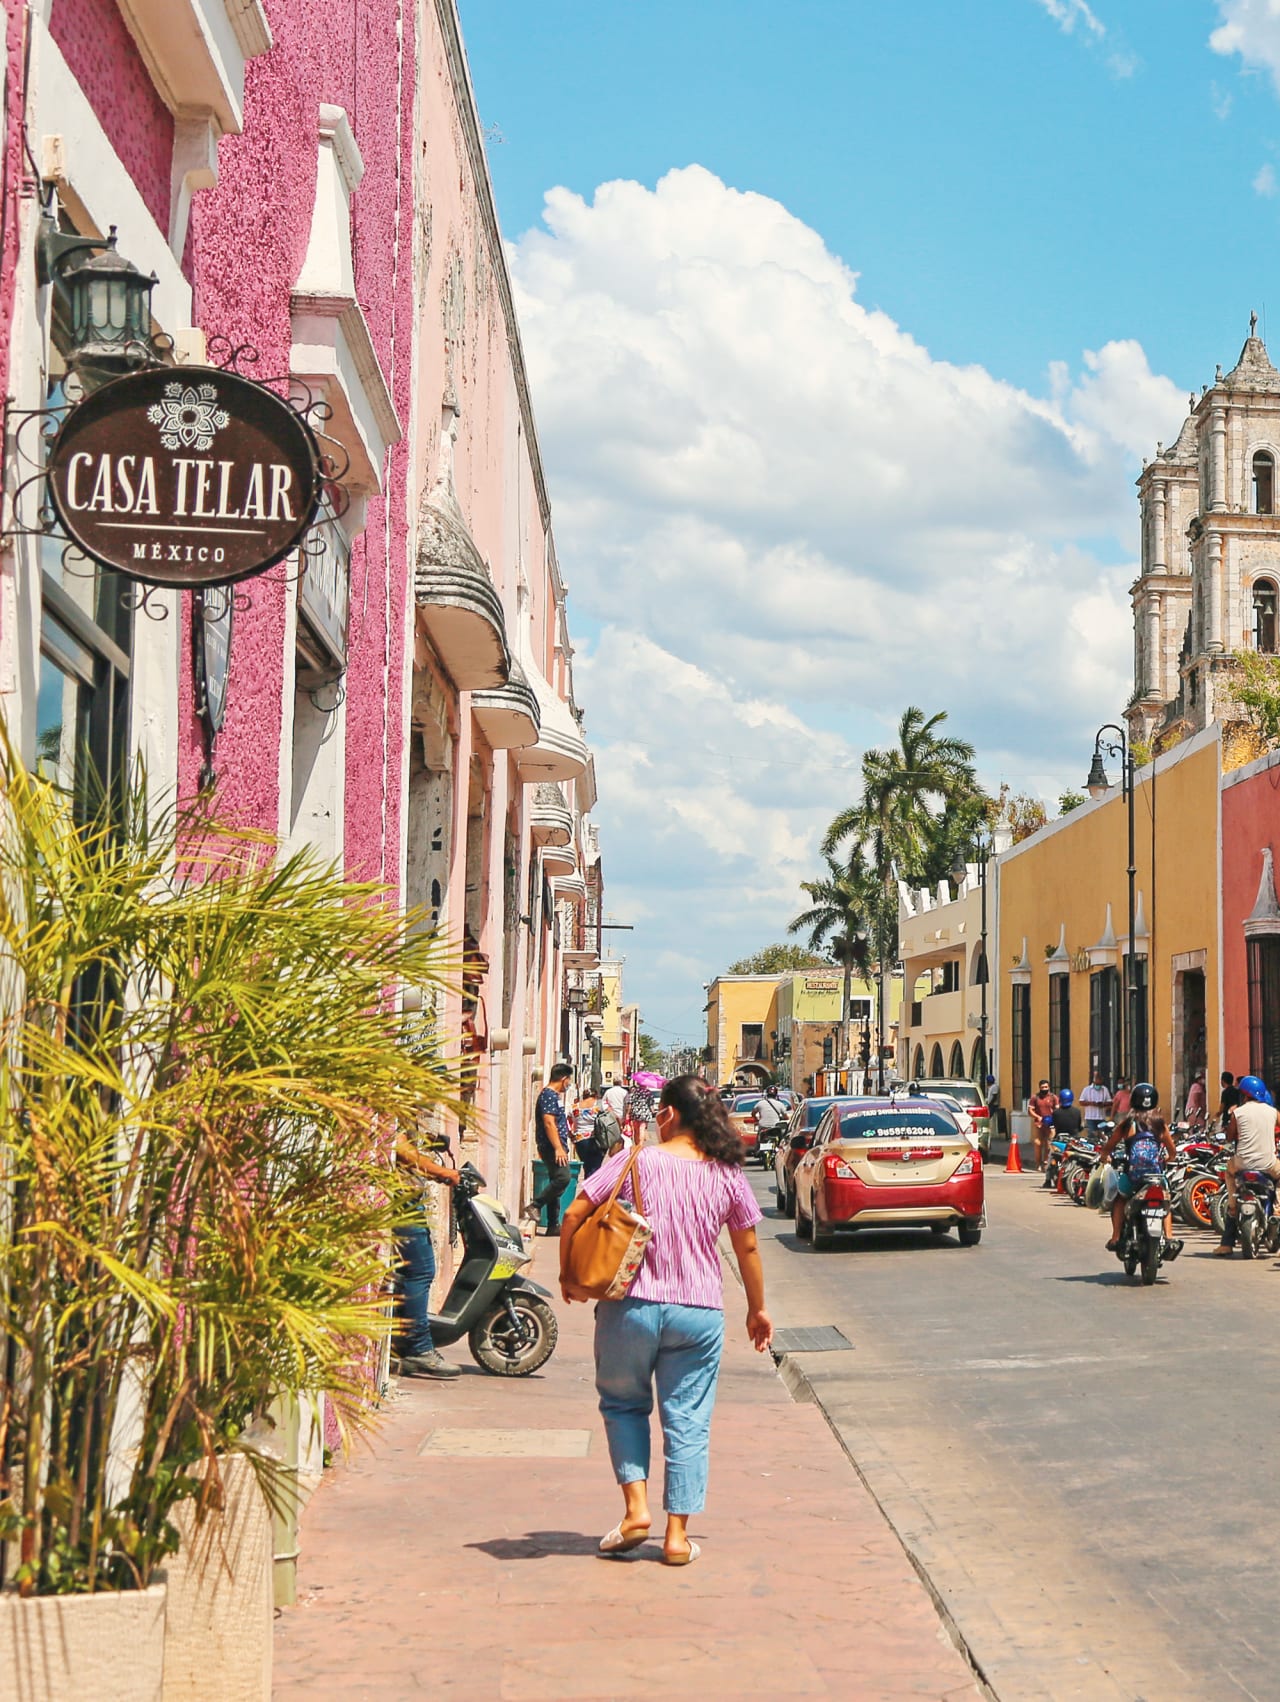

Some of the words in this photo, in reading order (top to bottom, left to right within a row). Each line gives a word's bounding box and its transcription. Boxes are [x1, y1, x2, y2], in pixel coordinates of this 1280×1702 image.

[66, 452, 160, 515] CASA
[172, 458, 297, 522] TELAR
[133, 542, 226, 563] MÉXICO
